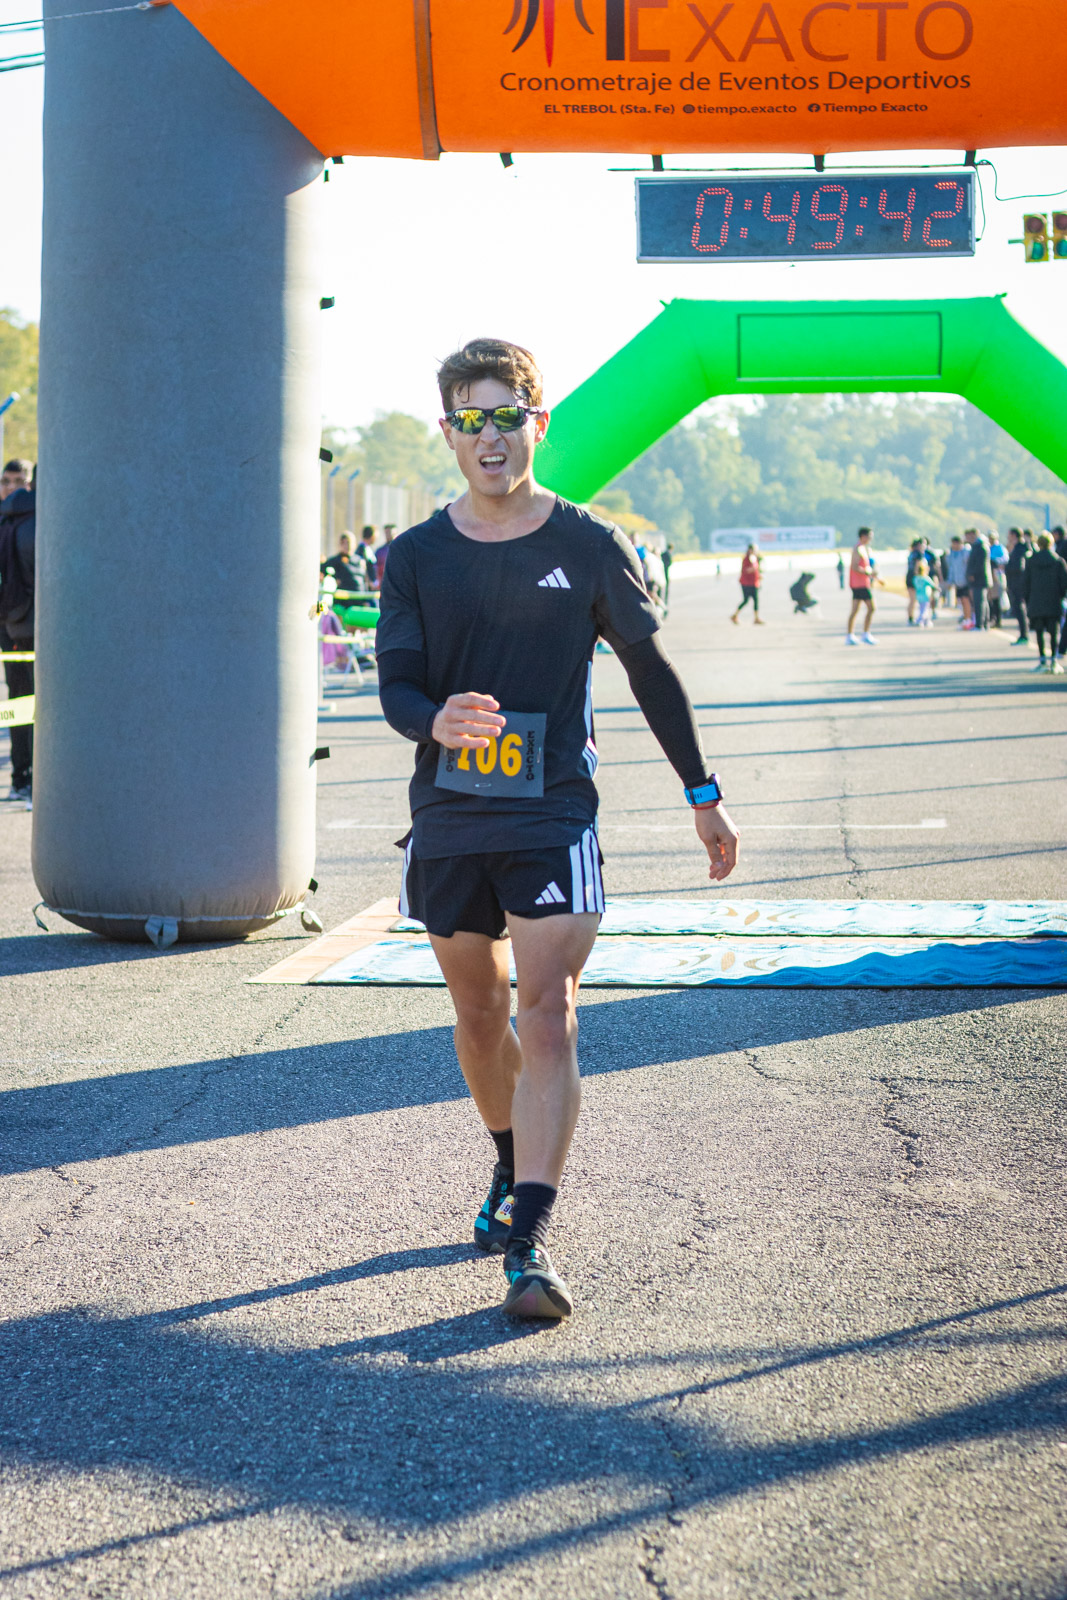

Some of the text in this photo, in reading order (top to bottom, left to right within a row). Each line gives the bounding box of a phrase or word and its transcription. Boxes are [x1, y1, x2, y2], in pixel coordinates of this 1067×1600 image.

[500, 71, 971, 95] Cronometraje de Eventos Deportivos
[544, 102, 928, 117] EL TREBOL (Sta. Fe) tiempo.exacto Tiempo Exacto
[691, 182, 964, 252] 0:49:42
[526, 731, 535, 780] EXACTO
